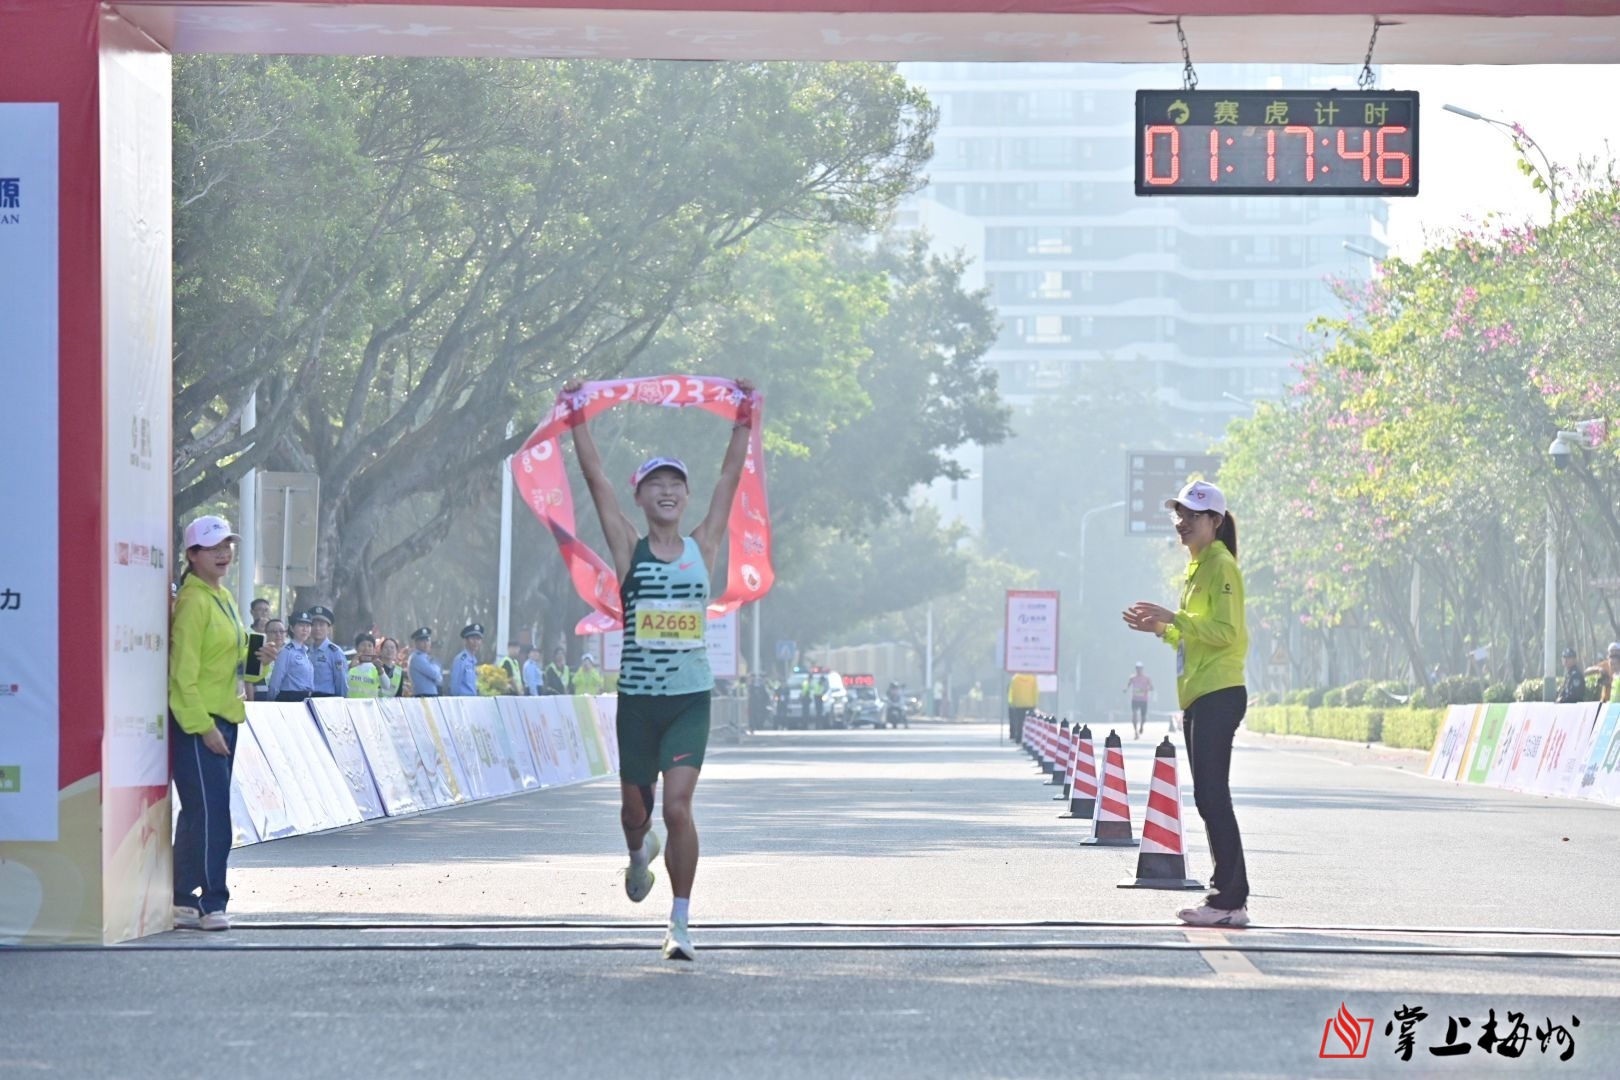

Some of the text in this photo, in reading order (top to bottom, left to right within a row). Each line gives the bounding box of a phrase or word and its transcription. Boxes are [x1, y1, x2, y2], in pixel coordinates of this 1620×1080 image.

[1213, 100, 1389, 125] 赛虎计时
[1144, 126, 1410, 185] 01:17:46
[0, 177, 20, 208] 原
[0, 587, 21, 610] 力
[641, 613, 697, 631] A2663
